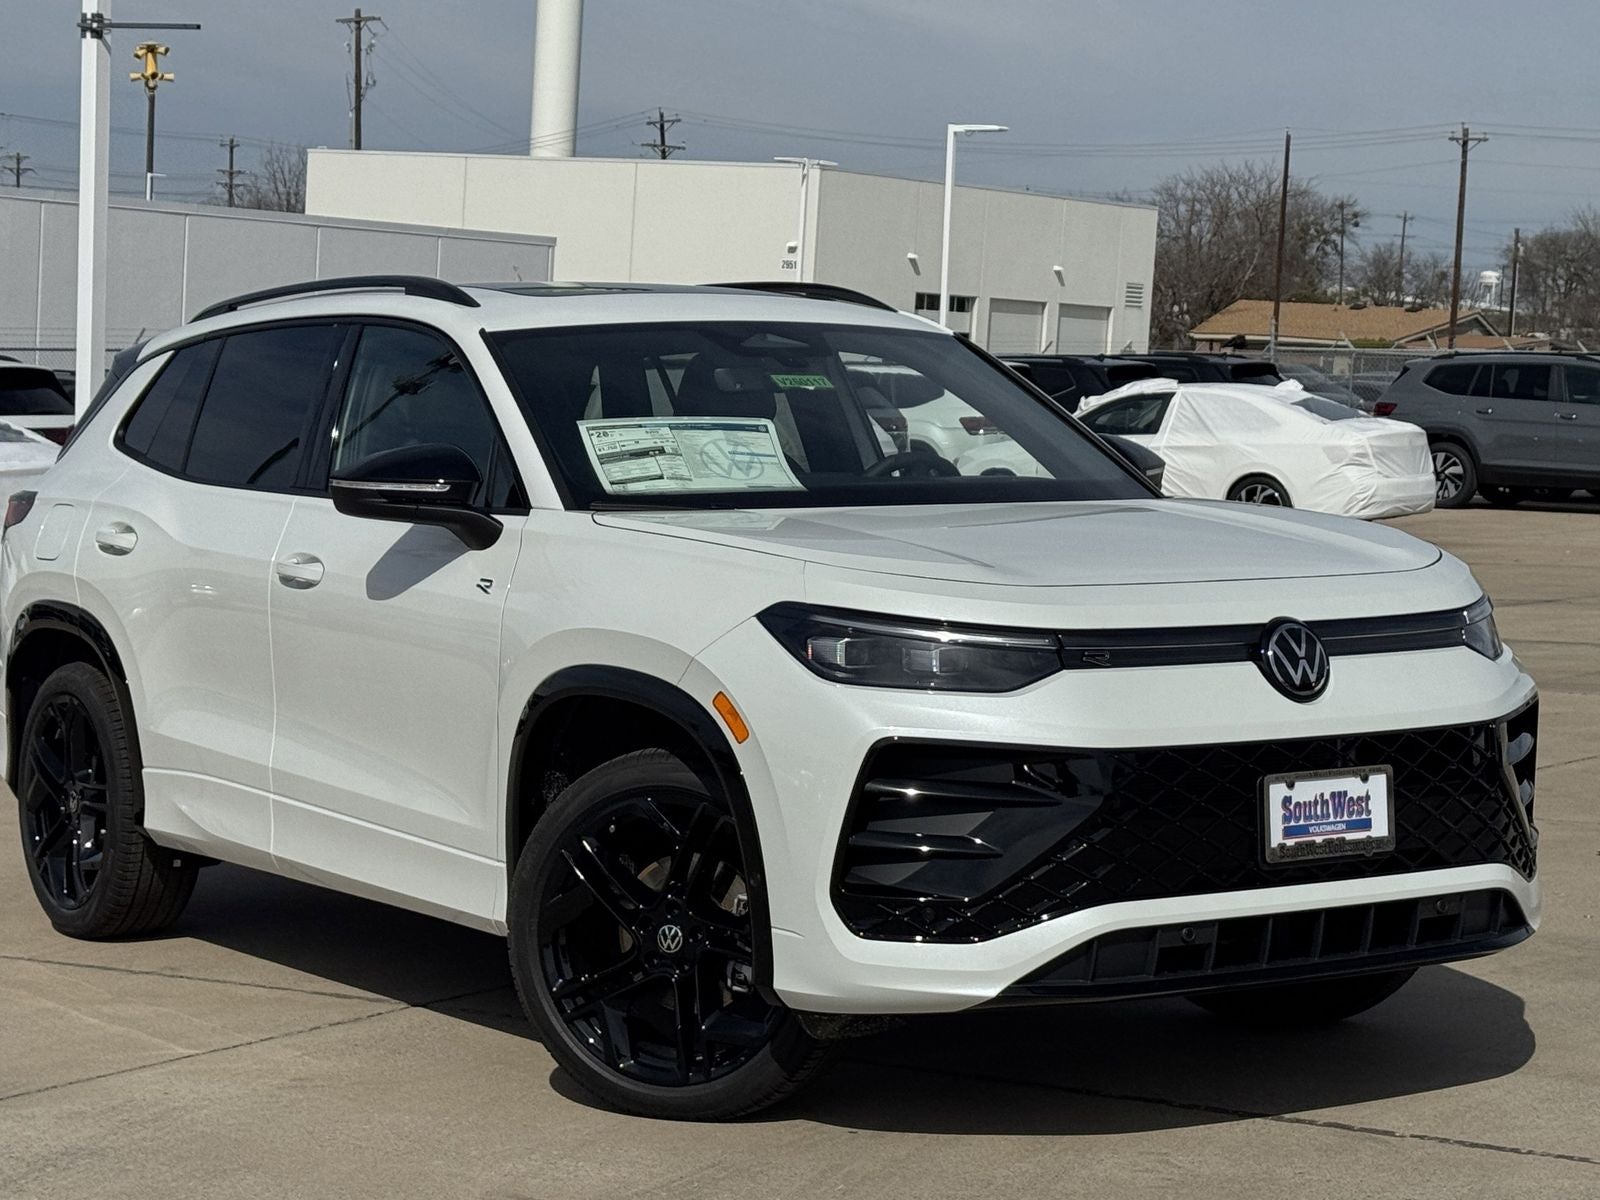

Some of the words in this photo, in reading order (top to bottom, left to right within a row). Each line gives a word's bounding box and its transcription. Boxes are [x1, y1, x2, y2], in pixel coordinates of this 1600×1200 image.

[1268, 623, 1328, 696] VW
[1281, 789, 1372, 825] SouthWest
[1308, 822, 1347, 834] VOLKSWAGEN
[657, 924, 683, 953] VW
